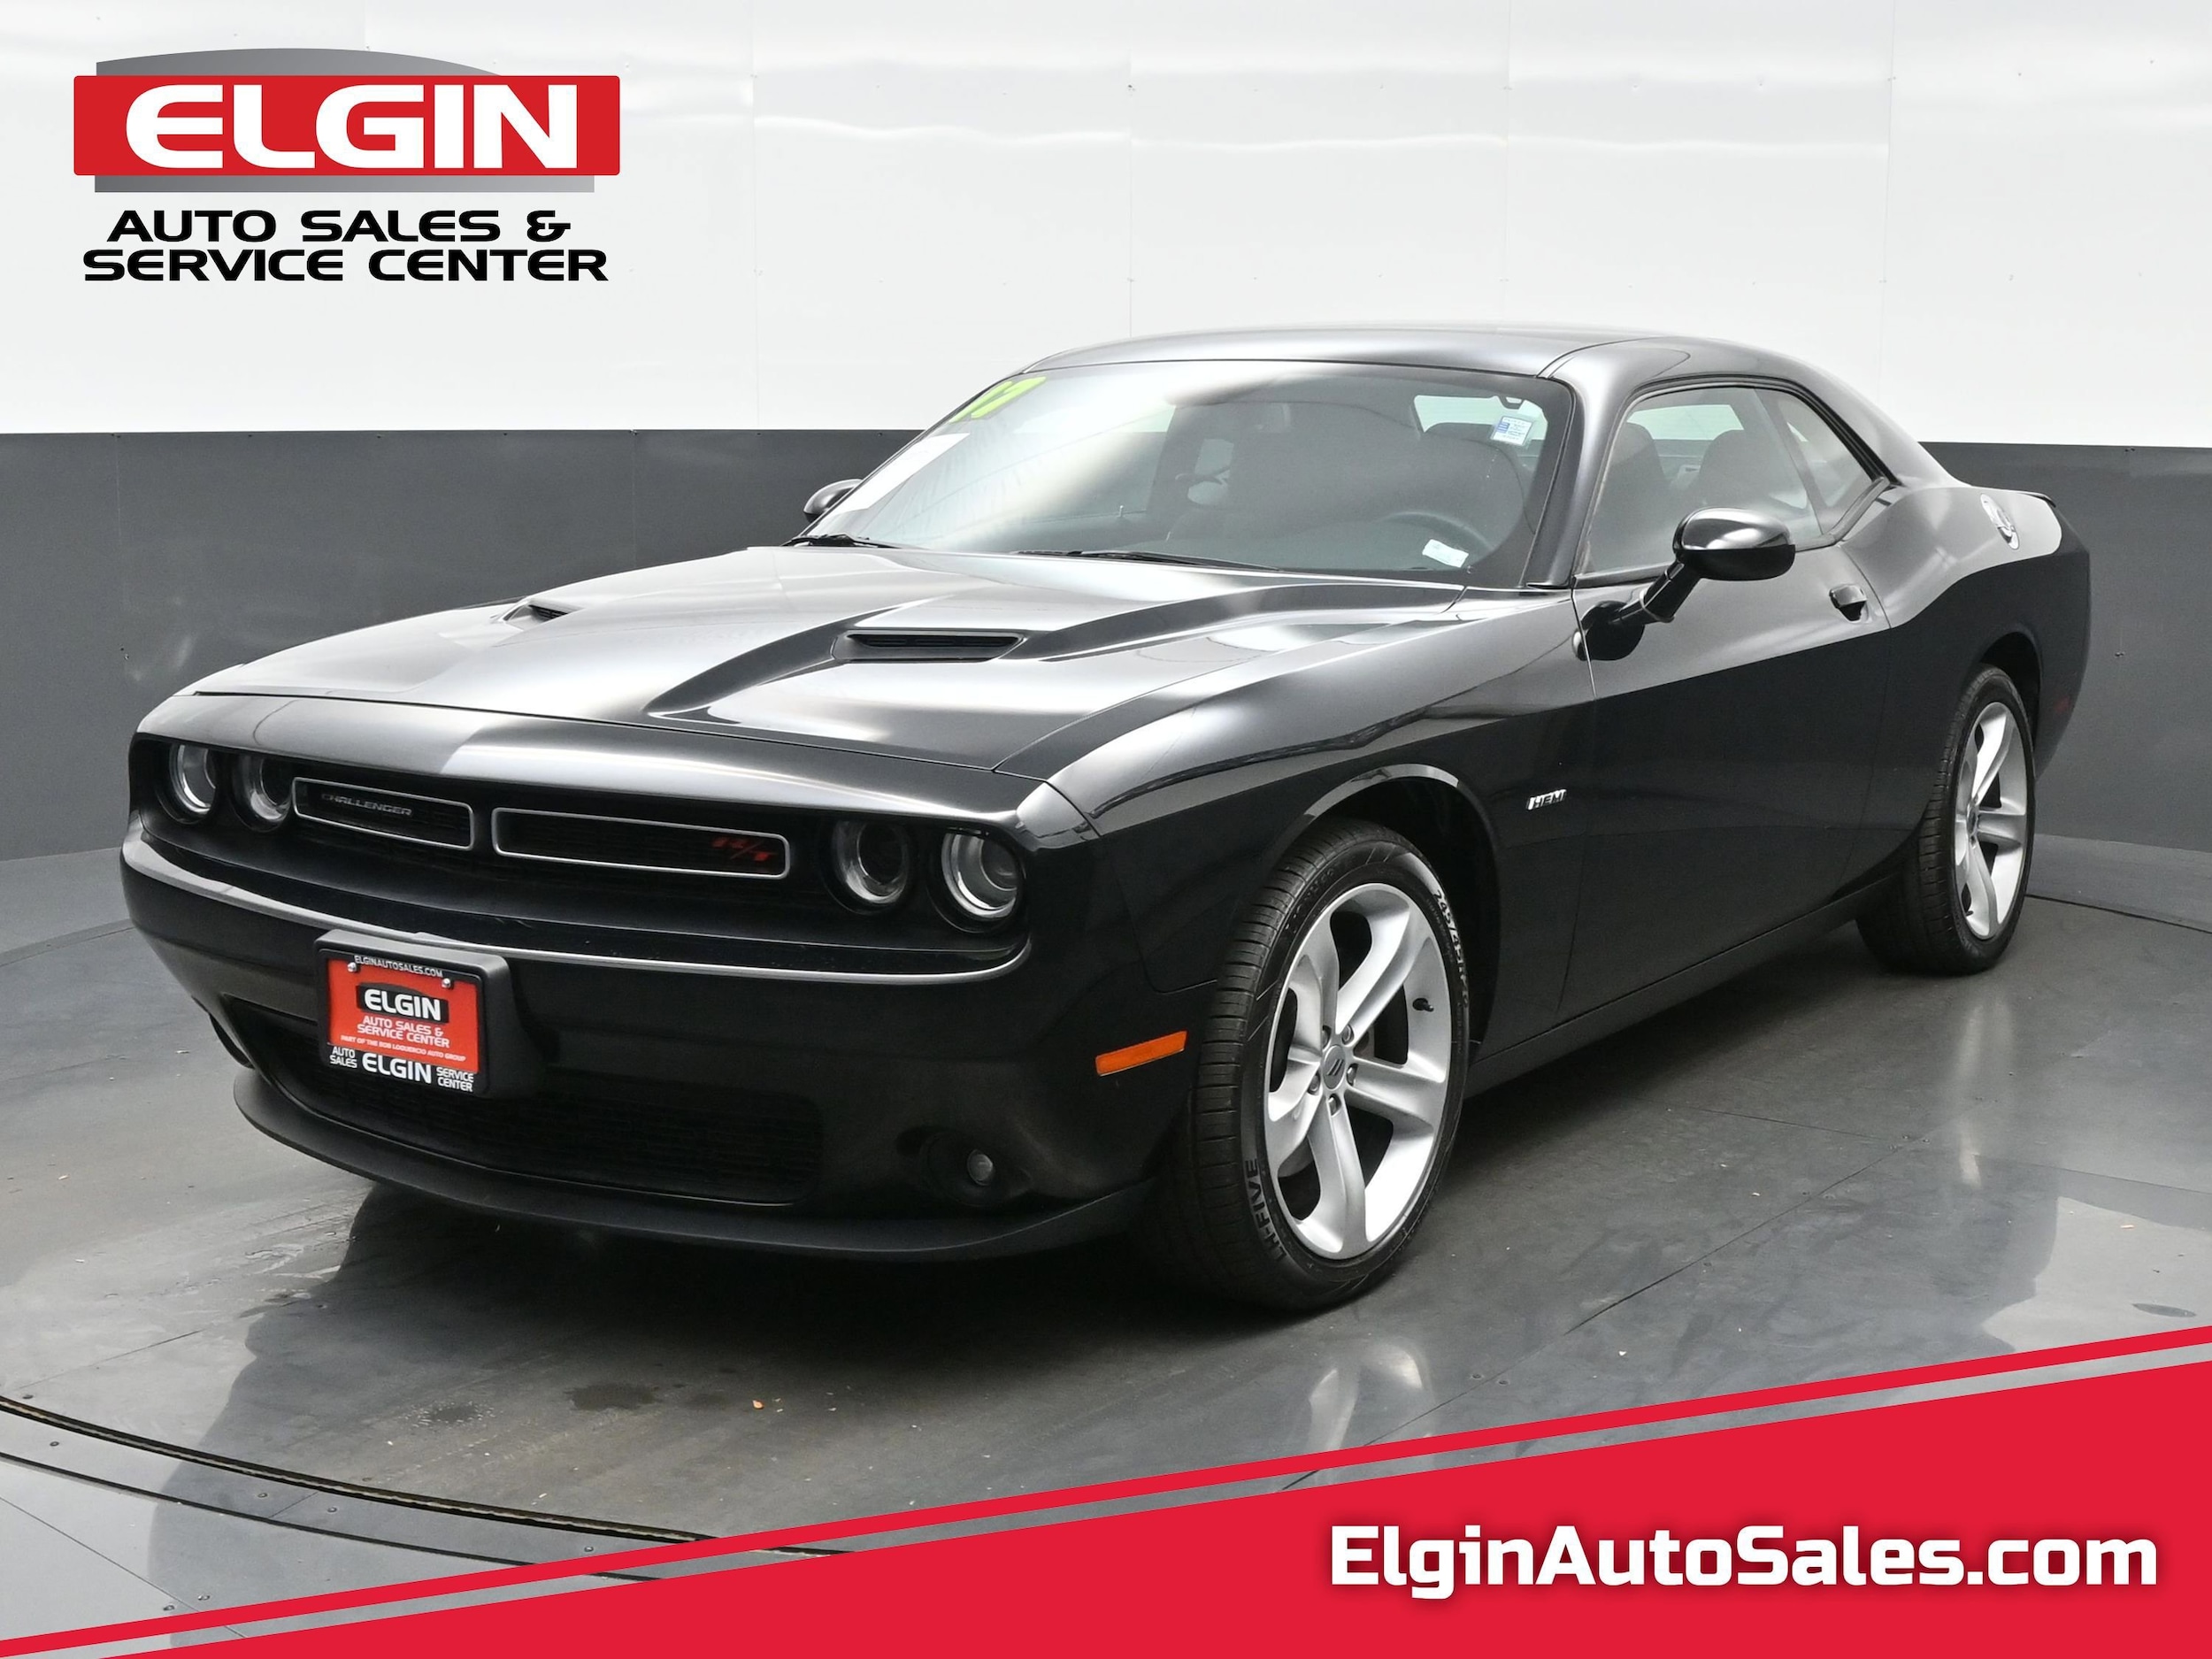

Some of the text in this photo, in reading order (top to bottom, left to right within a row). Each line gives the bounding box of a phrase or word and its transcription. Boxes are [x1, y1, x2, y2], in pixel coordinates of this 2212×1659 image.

[321, 793, 412, 816] CHALLENGER
[354, 955, 444, 978] ELGINAUTOSALES.COM
[364, 988, 442, 1021] ELGIN
[357, 1025, 450, 1048] SERVICE CENTER
[362, 1016, 444, 1037] AUTO SALES &
[329, 1055, 357, 1069] SALES
[332, 1046, 356, 1059] AUTO
[362, 1052, 432, 1084] ELGIN
[436, 1066, 474, 1083] SERVICE
[437, 1076, 473, 1093] CENTER
